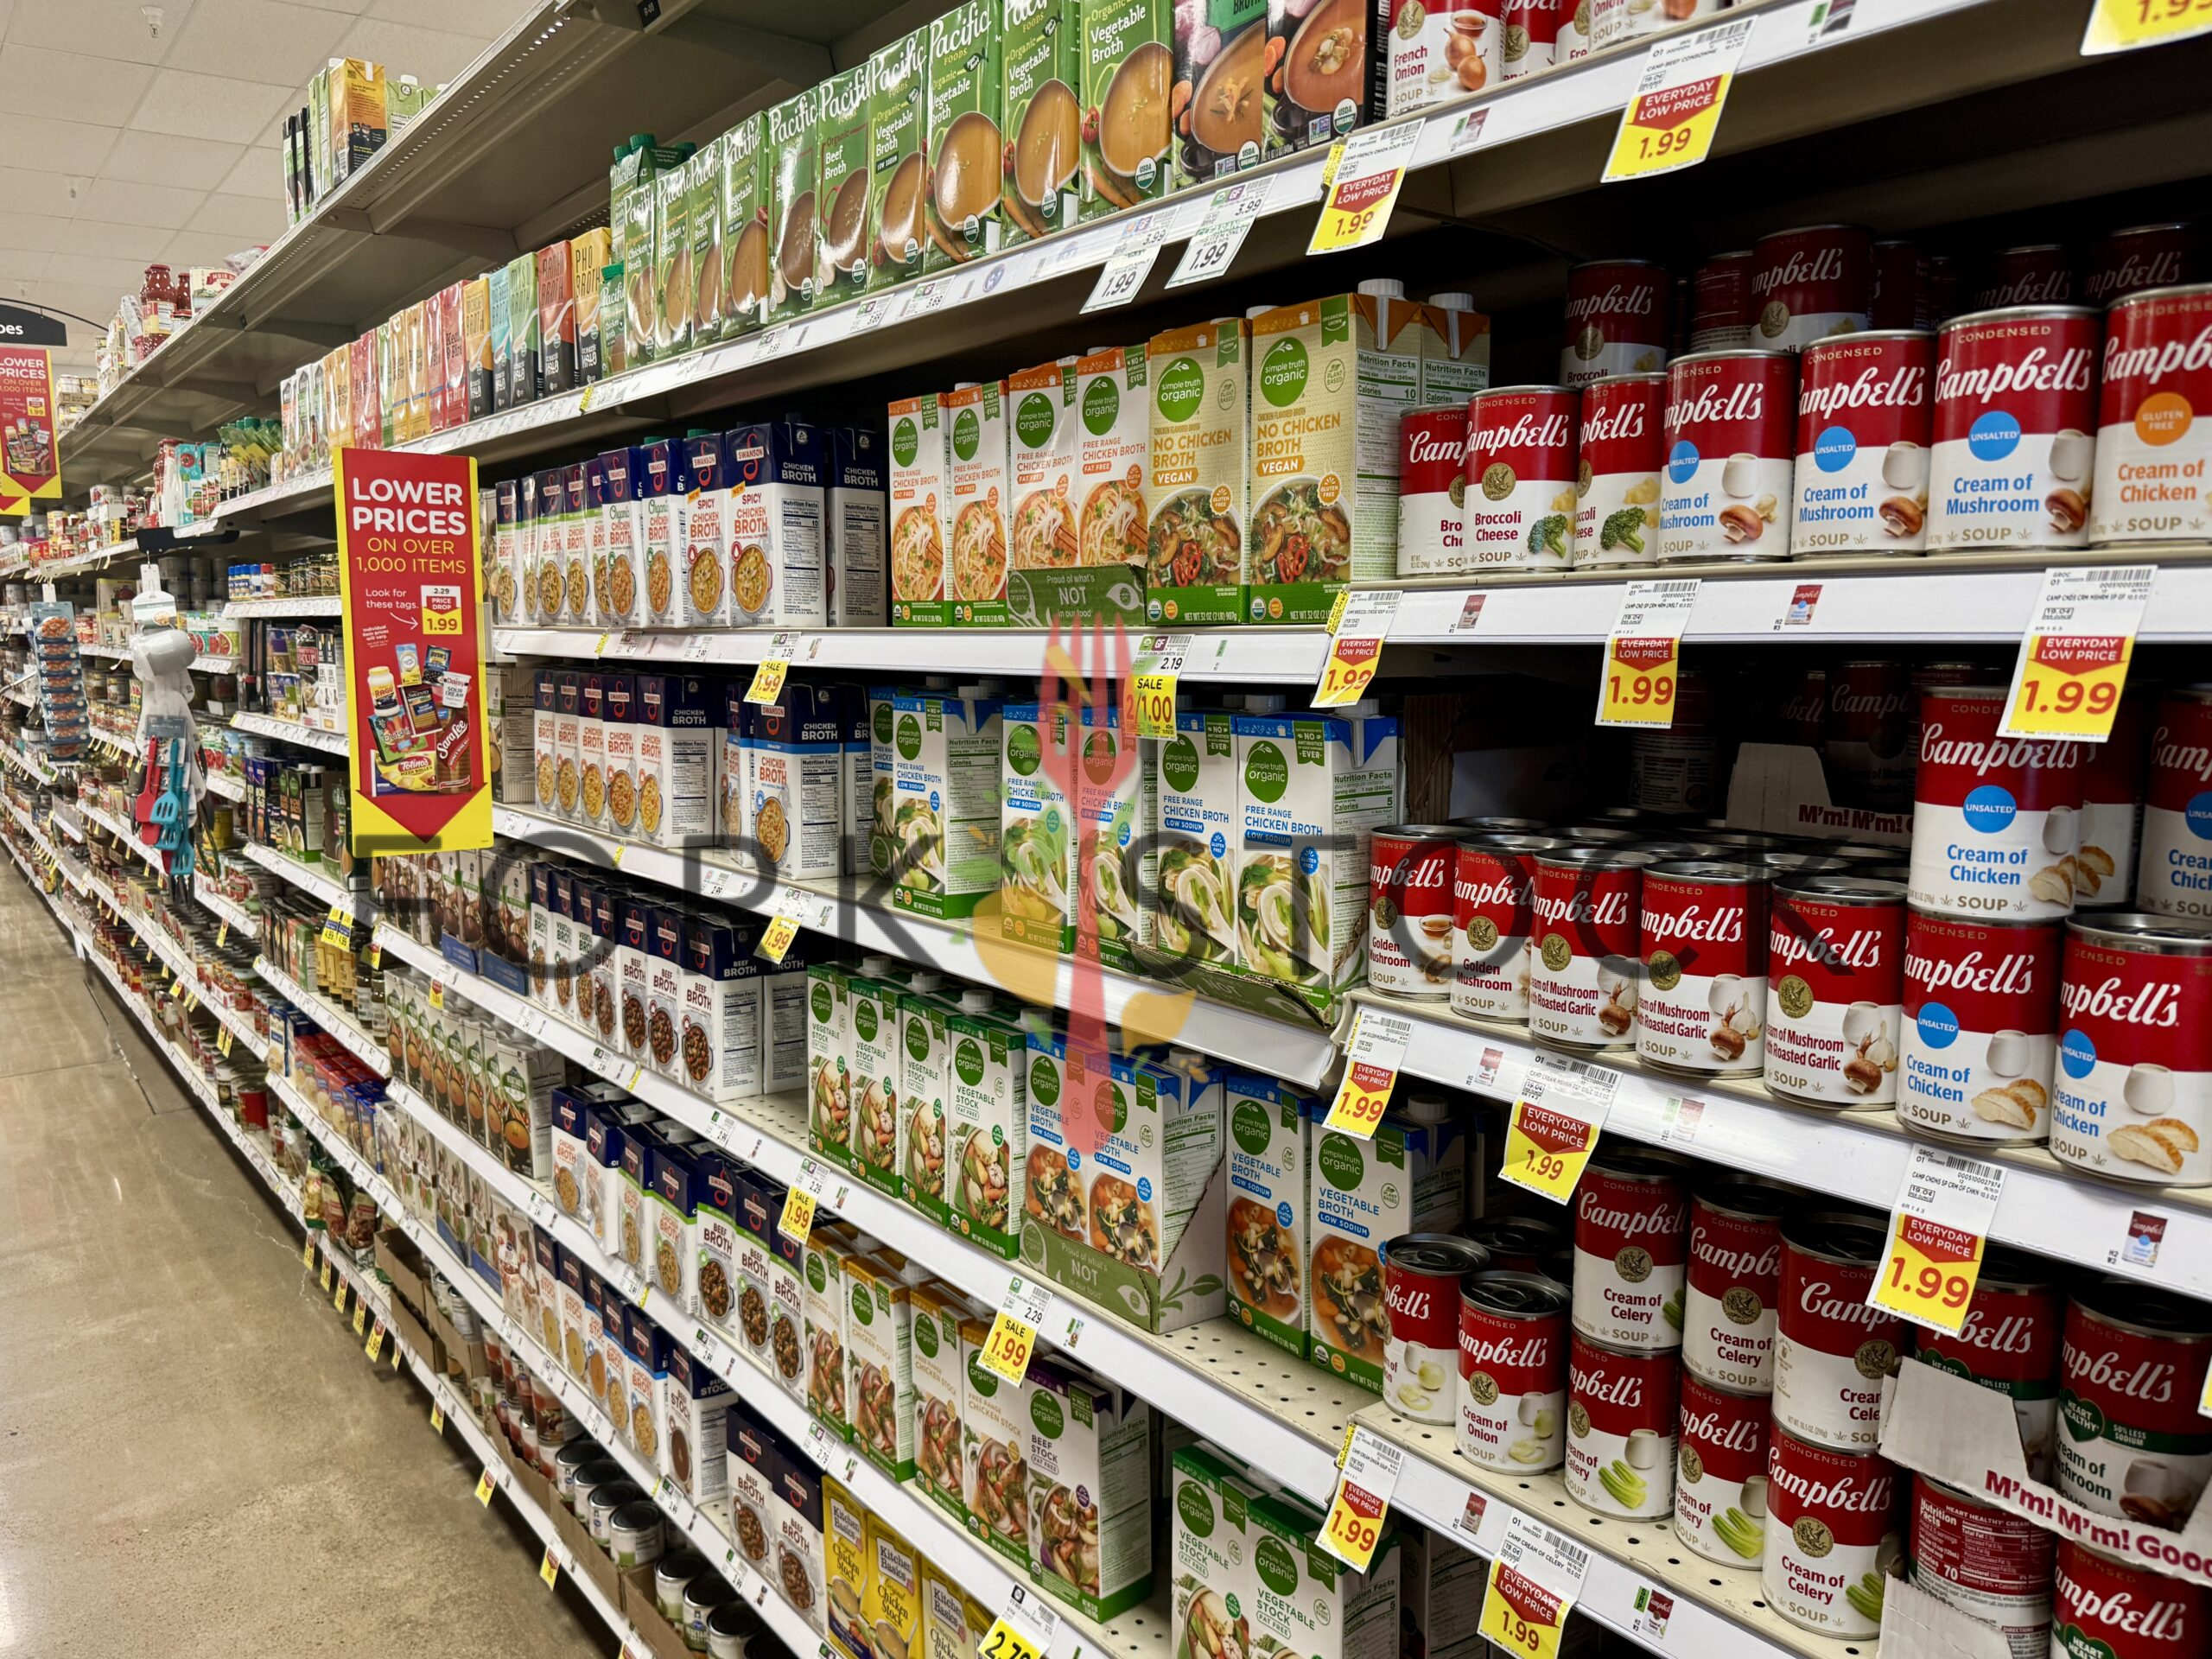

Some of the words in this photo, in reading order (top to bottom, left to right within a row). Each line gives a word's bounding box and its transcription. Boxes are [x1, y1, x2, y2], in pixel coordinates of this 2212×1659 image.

[930, 3, 991, 63] Pacific
[1090, 6, 1146, 43] Vegetable
[1009, 38, 1035, 60] Organic
[1091, 38, 1124, 64] Broth
[1393, 46, 1427, 67] French
[870, 34, 927, 97] Pacific
[1008, 46, 1051, 81] Vegetable
[1395, 63, 1425, 81] Onion
[1009, 74, 1033, 100] Broth
[1645, 80, 1715, 106] EVERYDAY
[1395, 89, 1423, 105] SOUP
[875, 104, 900, 121] Organic
[1639, 105, 1669, 121] LOW
[1673, 94, 1712, 114] PRICE
[770, 97, 817, 146] Pacific
[875, 111, 913, 140] Vegetable
[875, 137, 899, 156] Broth
[1639, 128, 1692, 159] 1.99
[825, 146, 843, 164] Beef
[825, 163, 847, 180] Broth
[1343, 173, 1393, 194] EVERYDAY
[1338, 190, 1361, 204] LOW
[1363, 183, 1391, 200] PRICE
[1235, 200, 1262, 216] 3.99
[1335, 211, 1374, 237] 1.99
[1189, 242, 1228, 270] 1.99
[1101, 270, 1136, 298] 1.99
[1958, 326, 2051, 344] CONDENSED
[1265, 364, 1287, 373] simple
[1288, 359, 1306, 370] truth
[1357, 353, 1389, 366] Nutrition
[1391, 358, 1416, 369] Facts
[1265, 368, 1306, 386] organic
[1357, 385, 1382, 396] Calories
[1404, 388, 1416, 399] 10
[1476, 397, 1535, 410] CONDENSED
[2143, 411, 2183, 422] GLUTEN
[2149, 420, 2174, 430] FREE
[1256, 423, 1277, 439] NO
[1281, 413, 1340, 435] CHICKEN
[737, 446, 764, 461] SWANSON
[1256, 437, 1301, 457] BROTH
[781, 470, 817, 483] BROTH
[783, 462, 814, 474] CHICKEN
[1261, 460, 1299, 475] VEGAN
[2118, 462, 2178, 481] Cream
[2183, 459, 2204, 478] of
[353, 477, 463, 505] LOWER
[732, 484, 745, 497] NEW
[1954, 476, 2010, 493] Cream
[2014, 474, 2033, 492] of
[741, 493, 762, 505] SPICY
[2120, 486, 2196, 503] Chicken
[736, 507, 766, 519] CHICKEN
[1947, 494, 2039, 515] Mushroom
[353, 506, 467, 536] PRICES
[735, 517, 768, 534] BROTH
[1475, 511, 1522, 526] Broccoli
[2127, 518, 2182, 531] SOUP
[1476, 527, 1518, 542] Cheese
[1961, 528, 2012, 542] SOUP
[367, 537, 397, 553] ON
[404, 538, 454, 554] OVER
[356, 557, 406, 573] 1,000
[413, 558, 466, 575] ITEMS
[1479, 551, 1512, 563] SOUP
[365, 588, 390, 597] Look
[393, 588, 406, 597] for
[366, 600, 393, 609] these
[396, 600, 419, 610] tags.
[427, 618, 458, 631] 1.99
[1621, 639, 1669, 649] EVERYDAY
[2046, 637, 2118, 649] EVERYDAY
[1619, 650, 1638, 658] LOW
[1642, 650, 1669, 658] PRICE
[2041, 650, 2074, 660] LOW
[2076, 650, 2116, 661] PRICE
[1160, 657, 1182, 671] 2.19
[1137, 677, 1162, 690] SALE
[1609, 675, 1674, 705] 1.99
[2024, 680, 2117, 715] 1.99
[1127, 692, 1172, 723] 2/1.00
[802, 728, 838, 741] BROTH
[803, 722, 836, 731] CHICKEN
[1272, 762, 1285, 771] truth
[1249, 770, 1286, 784] organic
[1245, 805, 1267, 816] FREE
[1268, 808, 1292, 819] RANGE
[1966, 804, 2012, 813] UNSALTED
[1244, 813, 1288, 832] CHICKEN
[1291, 823, 1323, 837] BROTH
[1247, 831, 1262, 841] LOW
[1263, 834, 1291, 845] SODIUM
[1948, 844, 2005, 864] Cream
[2008, 849, 2028, 864] of
[1950, 866, 2020, 886] Chicken
[1645, 880, 1703, 896] CONDENSED
[1957, 895, 2008, 911] SOUP
[1642, 906, 1743, 944] ampbell's
[662, 969, 672, 980] BEEF
[1464, 958, 1501, 976] Golden
[653, 977, 677, 995] BROTH
[1457, 972, 1512, 992] Mushroom
[1465, 995, 1496, 1011] SOUP
[1918, 1019, 1956, 1033] UNSALTED
[1907, 1054, 1949, 1080] Cream
[1952, 1065, 1970, 1084] of
[956, 1085, 995, 1106] VEGETABLE
[1908, 1075, 1963, 1103] Chicken
[956, 1095, 979, 1109] STOCK
[1911, 1104, 1952, 1125] SOUP
[1318, 1198, 1354, 1219] BROTH
[1319, 1186, 1380, 1217] VEGETABLE
[1910, 1218, 1972, 1245] EVERYDAY
[1908, 1230, 1934, 1245] LOW
[1936, 1238, 1971, 1258] PRICE
[1071, 1259, 1100, 1287] NOT
[1890, 1256, 1969, 1309] 1.99
[1604, 1287, 1643, 1306] Cream
[1648, 1294, 1662, 1306] of
[1611, 1305, 1653, 1325] Celery
[1004, 1319, 1026, 1338] SALE
[988, 1331, 1027, 1369] 1.99
[879, 1544, 912, 1572] Kitchen
[1546, 1554, 1564, 1569] CELERY
[880, 1554, 907, 1583] Basics
[1944, 1565, 1958, 1580] 70
